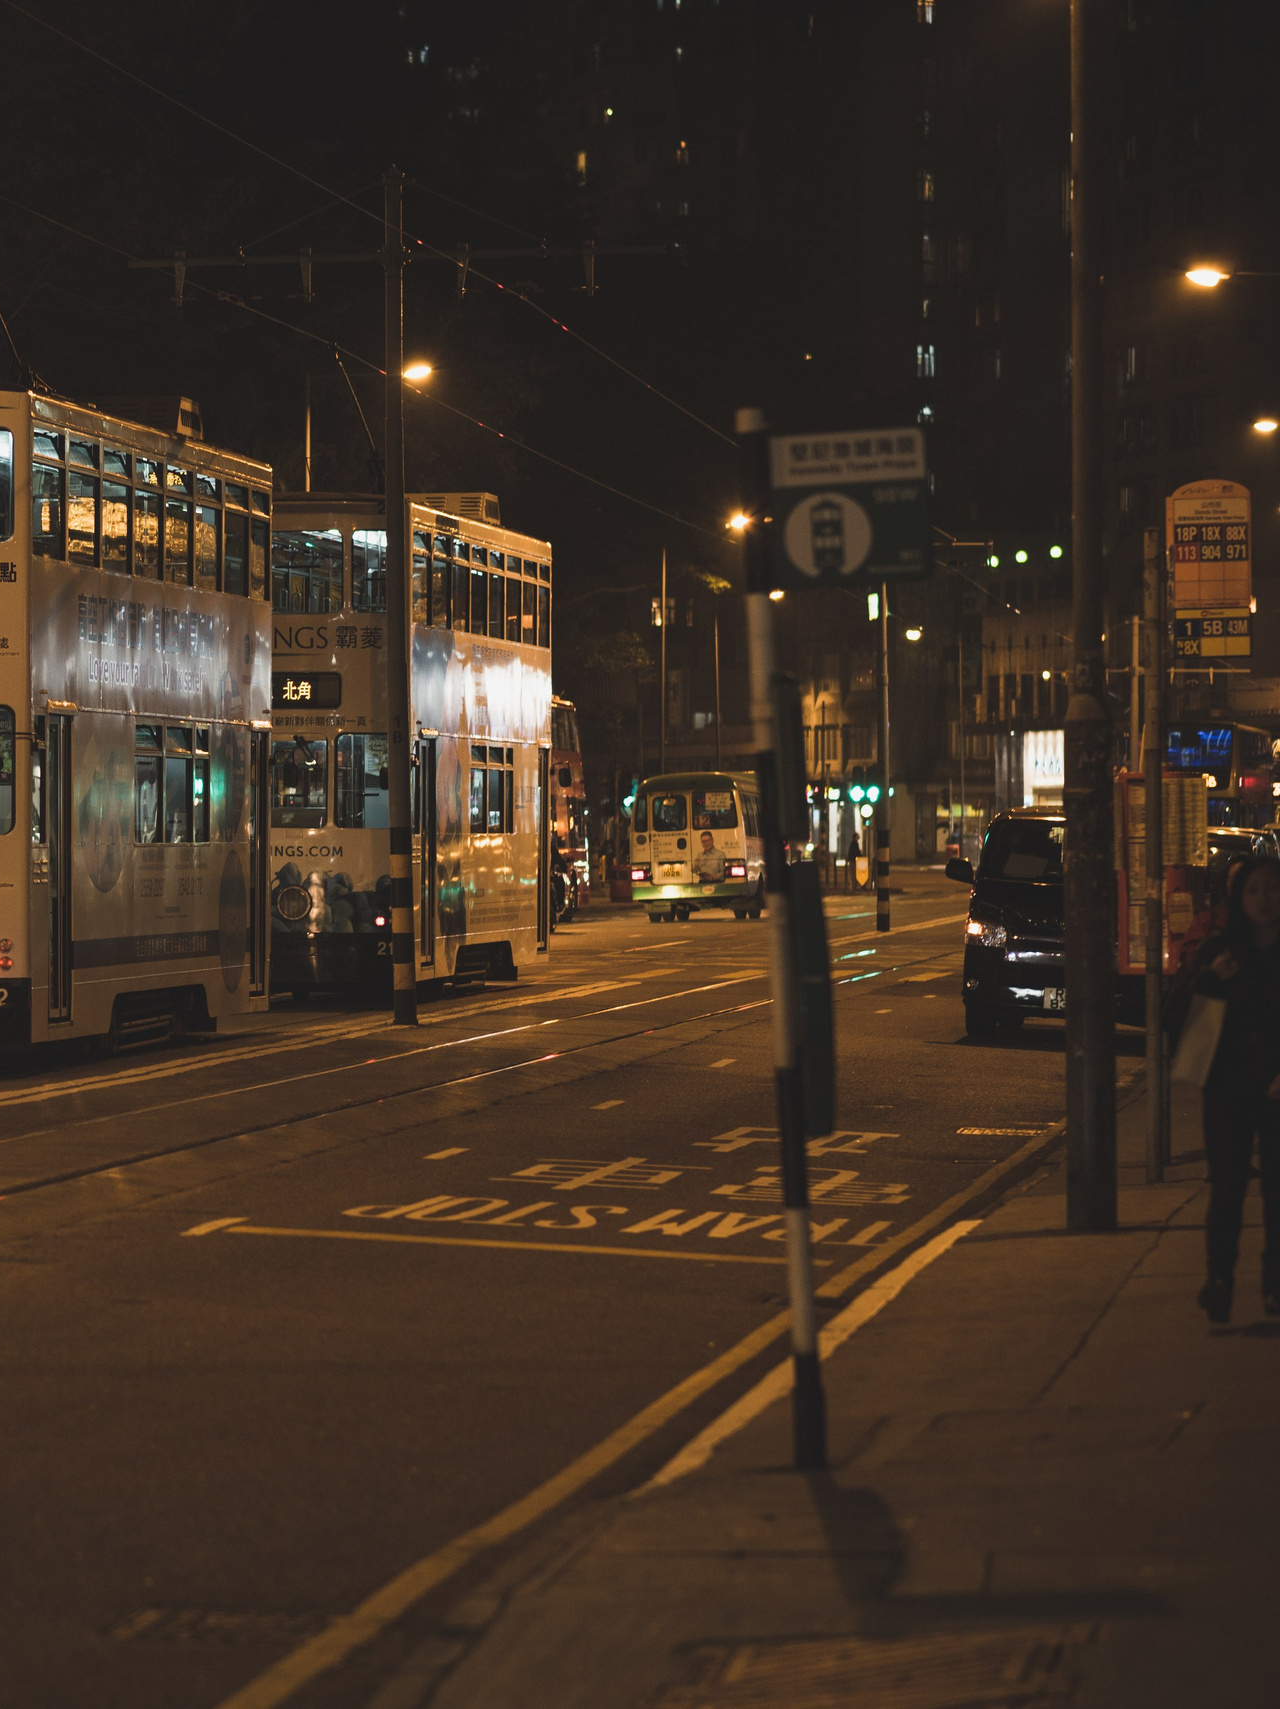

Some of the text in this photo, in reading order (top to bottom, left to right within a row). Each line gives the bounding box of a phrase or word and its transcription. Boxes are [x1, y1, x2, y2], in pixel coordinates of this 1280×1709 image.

[1176, 526, 1197, 542] 18P
[1201, 526, 1221, 541] 18X
[1226, 525, 1246, 540] 88X
[1177, 546, 1197, 561] 113
[1202, 545, 1221, 560] 904
[1227, 545, 1247, 559] 971
[1185, 621, 1192, 636] 1
[1203, 620, 1223, 635] 5B
[1227, 620, 1248, 634] 43M
[336, 626, 382, 650] 霸菱
[282, 681, 312, 701] 北角
[341, 1194, 894, 1247] TRAM STOP
